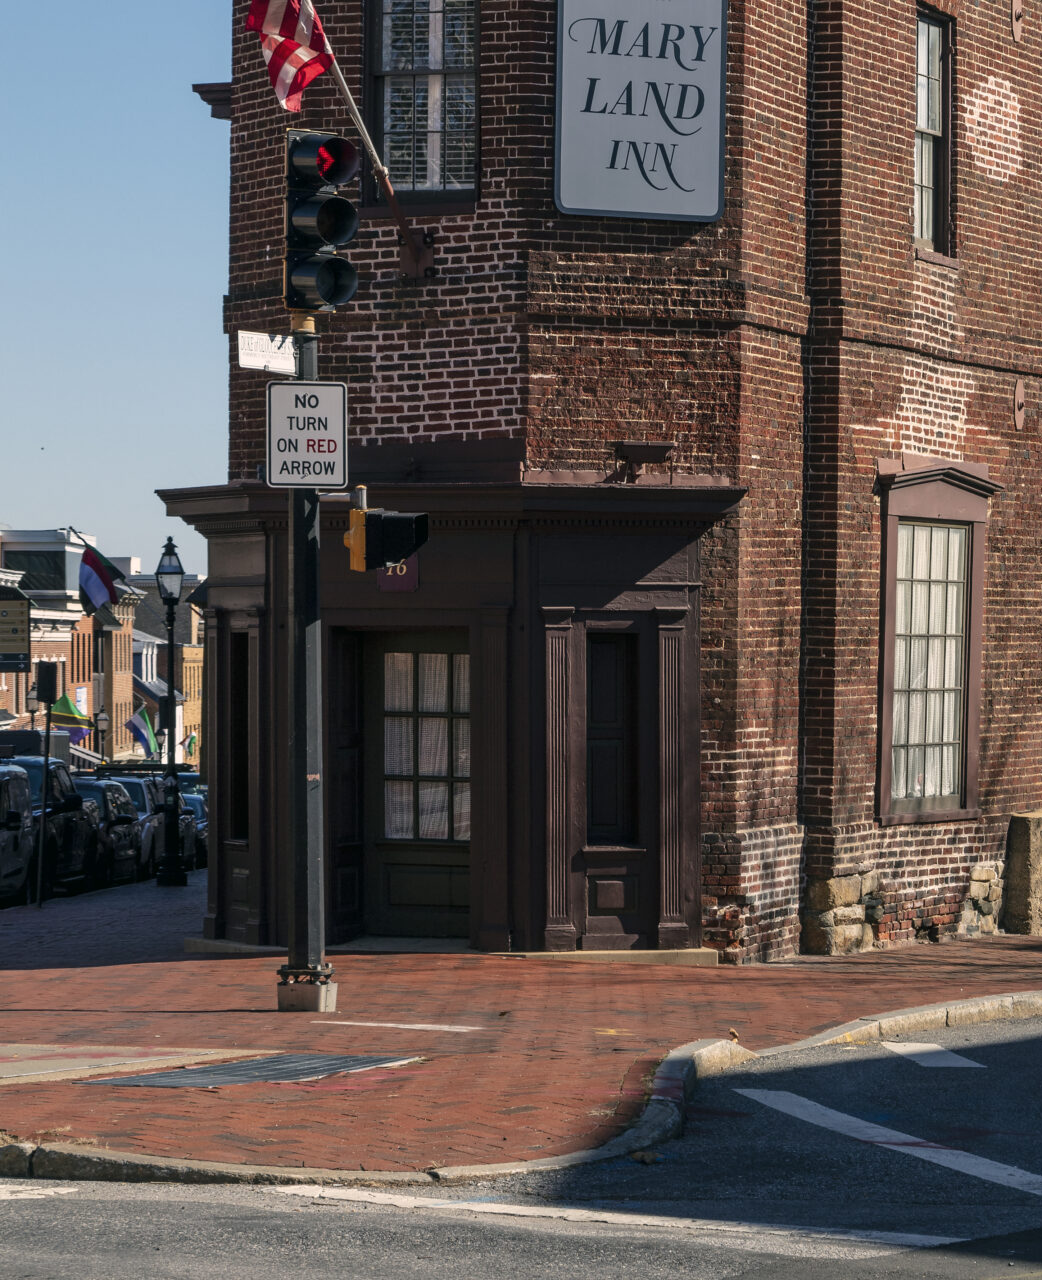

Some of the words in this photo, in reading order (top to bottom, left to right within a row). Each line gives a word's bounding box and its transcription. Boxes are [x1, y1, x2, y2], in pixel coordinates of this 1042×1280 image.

[568, 17, 718, 71] MARY
[580, 78, 706, 136] LAND
[606, 140, 696, 193] INN
[294, 394, 320, 409] NO
[287, 416, 328, 431] TURN
[276, 438, 299, 453] ON
[306, 439, 338, 454] RED
[279, 460, 336, 476] ARROW
